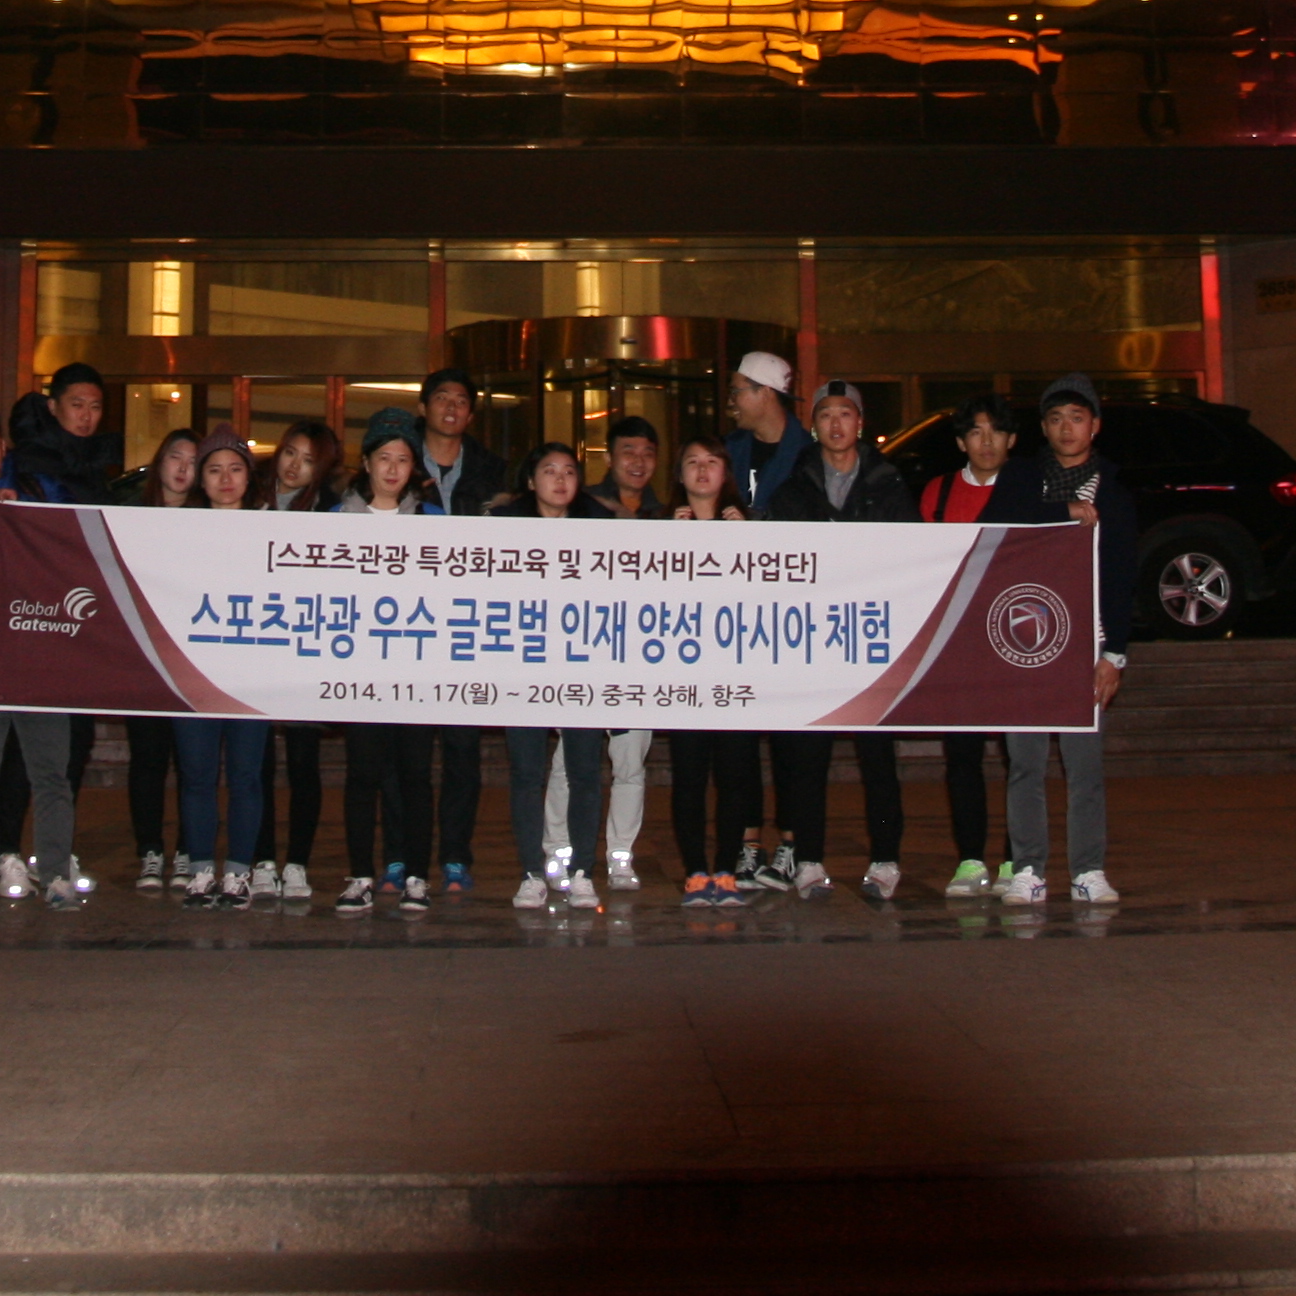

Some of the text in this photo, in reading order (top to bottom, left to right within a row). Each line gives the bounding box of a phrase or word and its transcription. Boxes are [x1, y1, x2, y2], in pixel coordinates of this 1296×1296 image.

[267, 541, 817, 584] [스포츠관광 특성화교육 및 지역서비스 사업단]
[9, 599, 60, 616] Global
[8, 615, 81, 637] Gateway
[187, 592, 890, 664] 스포츠관광 우수 글로벌 인재 양성 아시아 체험
[319, 681, 383, 702] 2014.
[391, 683, 424, 702] 11.
[434, 683, 499, 705] 17(월)
[527, 684, 594, 706] 20(목)
[601, 684, 646, 707] 중국
[652, 684, 704, 708] 상해,
[712, 684, 757, 707] 항주
